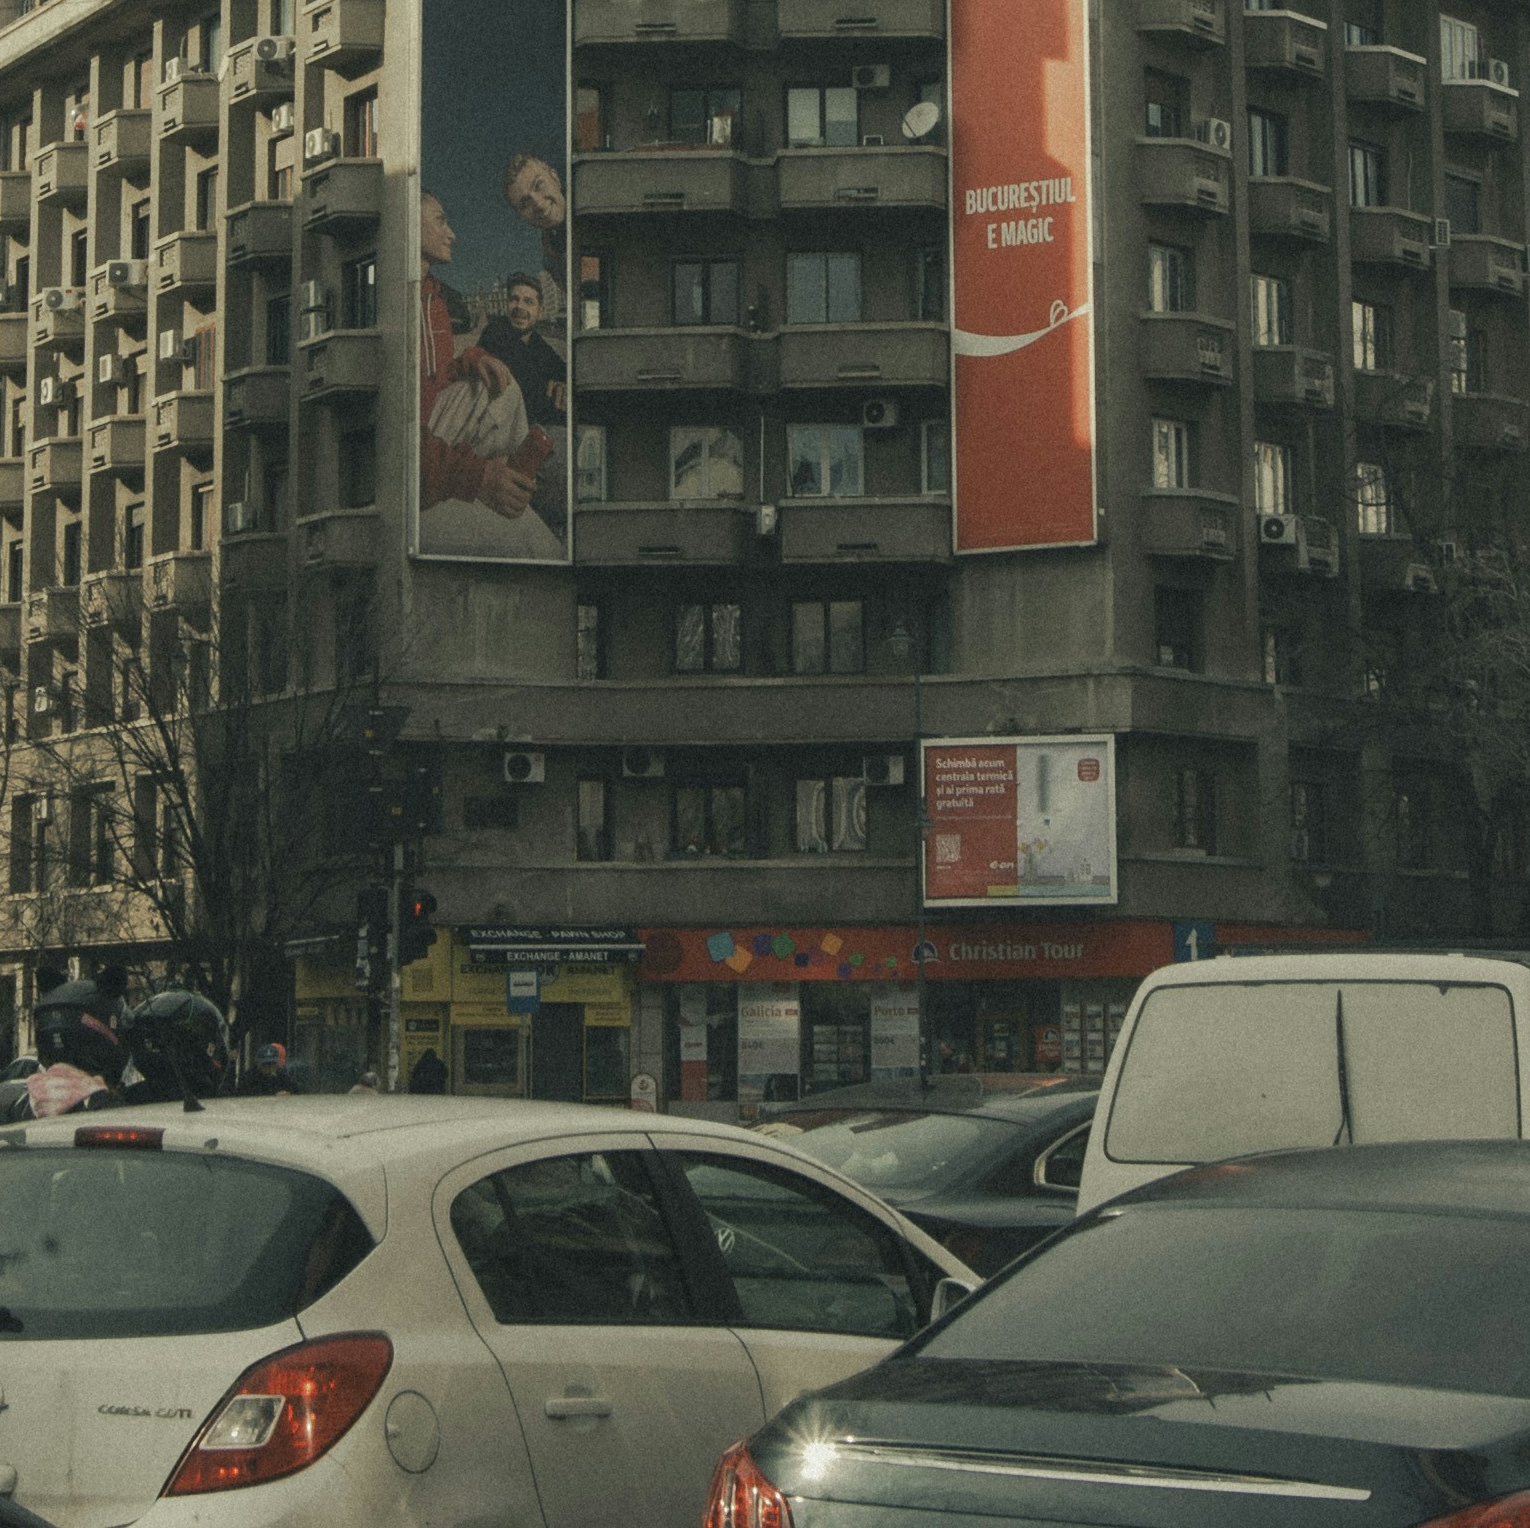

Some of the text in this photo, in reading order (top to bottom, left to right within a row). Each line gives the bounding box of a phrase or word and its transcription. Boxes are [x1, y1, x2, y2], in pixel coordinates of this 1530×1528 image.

[966, 177, 1076, 214] BUCUREȘTIUL
[987, 217, 1054, 249] E MAGIC
[935, 757, 1005, 769] Schimbă acum
[976, 769, 1014, 782] termică
[945, 783, 955, 795] ai
[955, 783, 984, 797] prima
[984, 782, 1006, 795] rată
[935, 797, 975, 811] gratuită
[470, 929, 626, 940] EXCHANGE PAWN SHOP
[506, 951, 609, 961] EXCHANGE AMANET
[949, 939, 1085, 961] Christian Tour
[741, 1006, 783, 1018] Galicia
[874, 1006, 905, 1016] Porto
